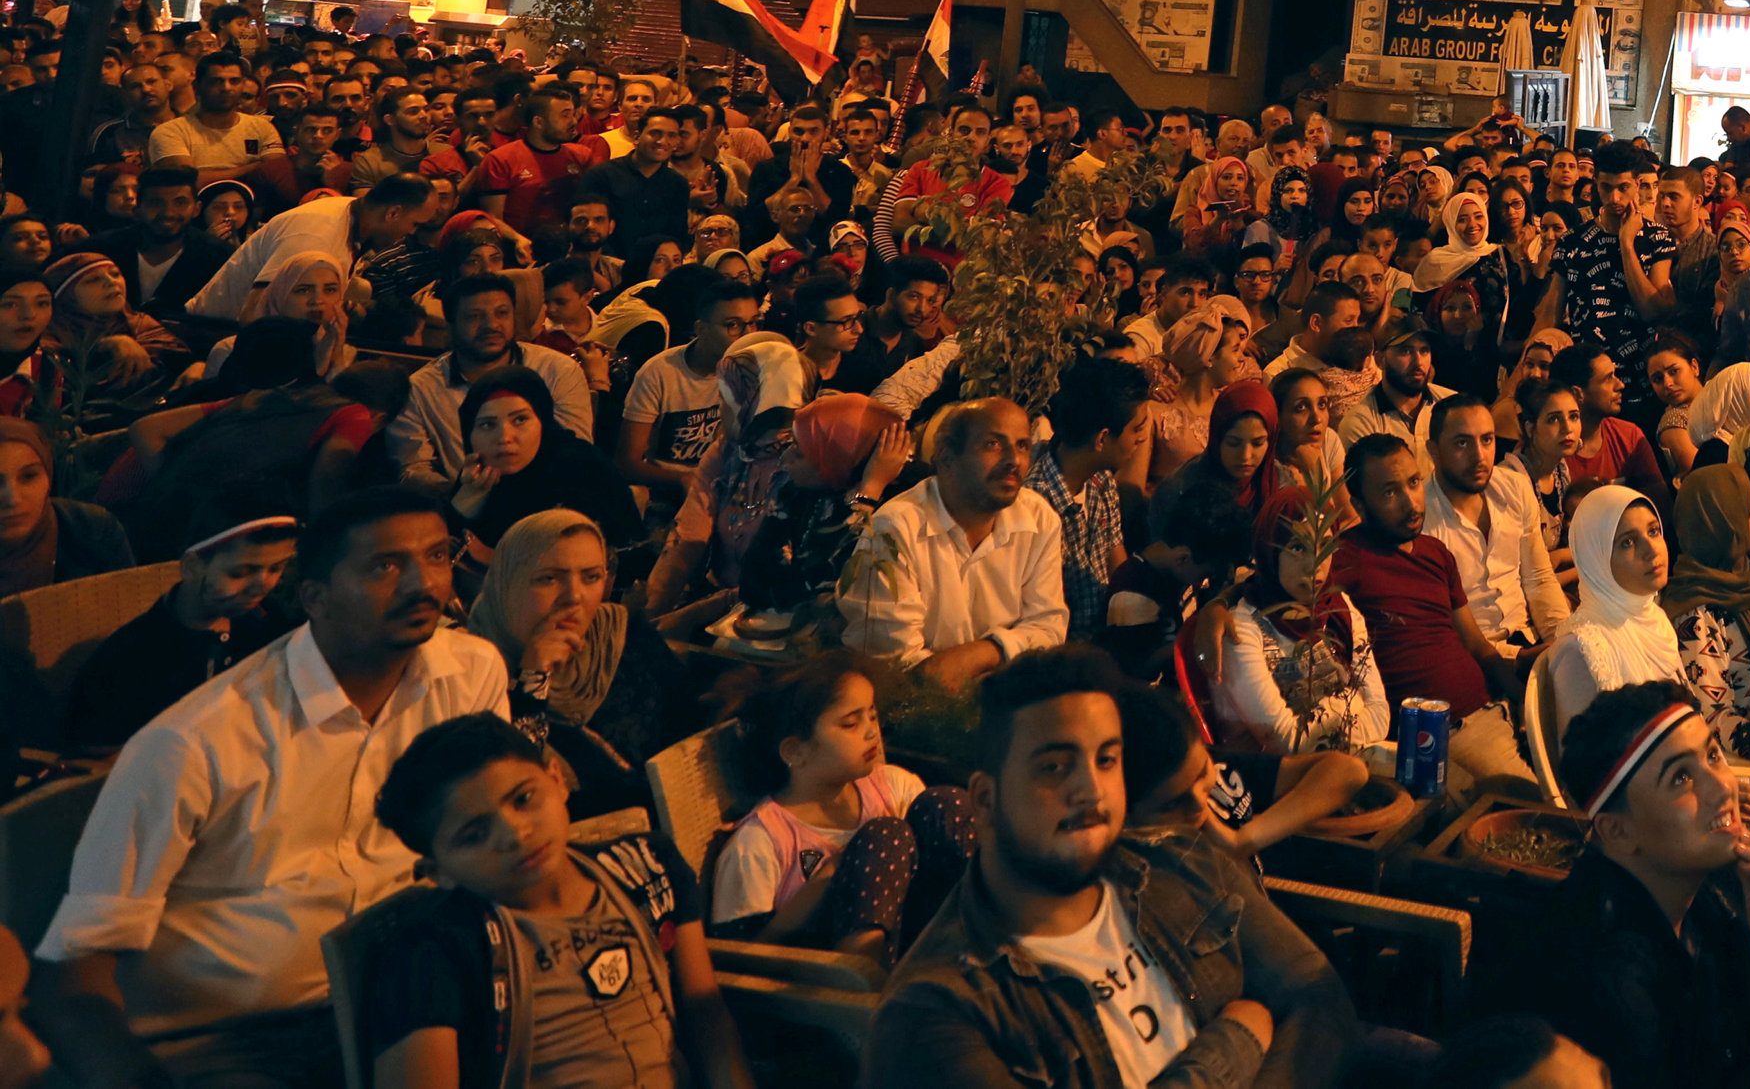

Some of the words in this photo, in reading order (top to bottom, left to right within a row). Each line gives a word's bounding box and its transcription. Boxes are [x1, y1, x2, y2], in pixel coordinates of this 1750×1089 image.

[1389, 37, 1431, 57] ARAB
[1436, 40, 1486, 61] GROUP
[1584, 226, 1600, 243] PARIS
[1597, 236, 1617, 245] LOUIS
[1586, 260, 1612, 278] VUITTON
[1592, 297, 1611, 306] LOUIS
[1619, 343, 1639, 358] PARIS
[686, 412, 705, 426] STAY
[1128, 1005, 1160, 1045] D
